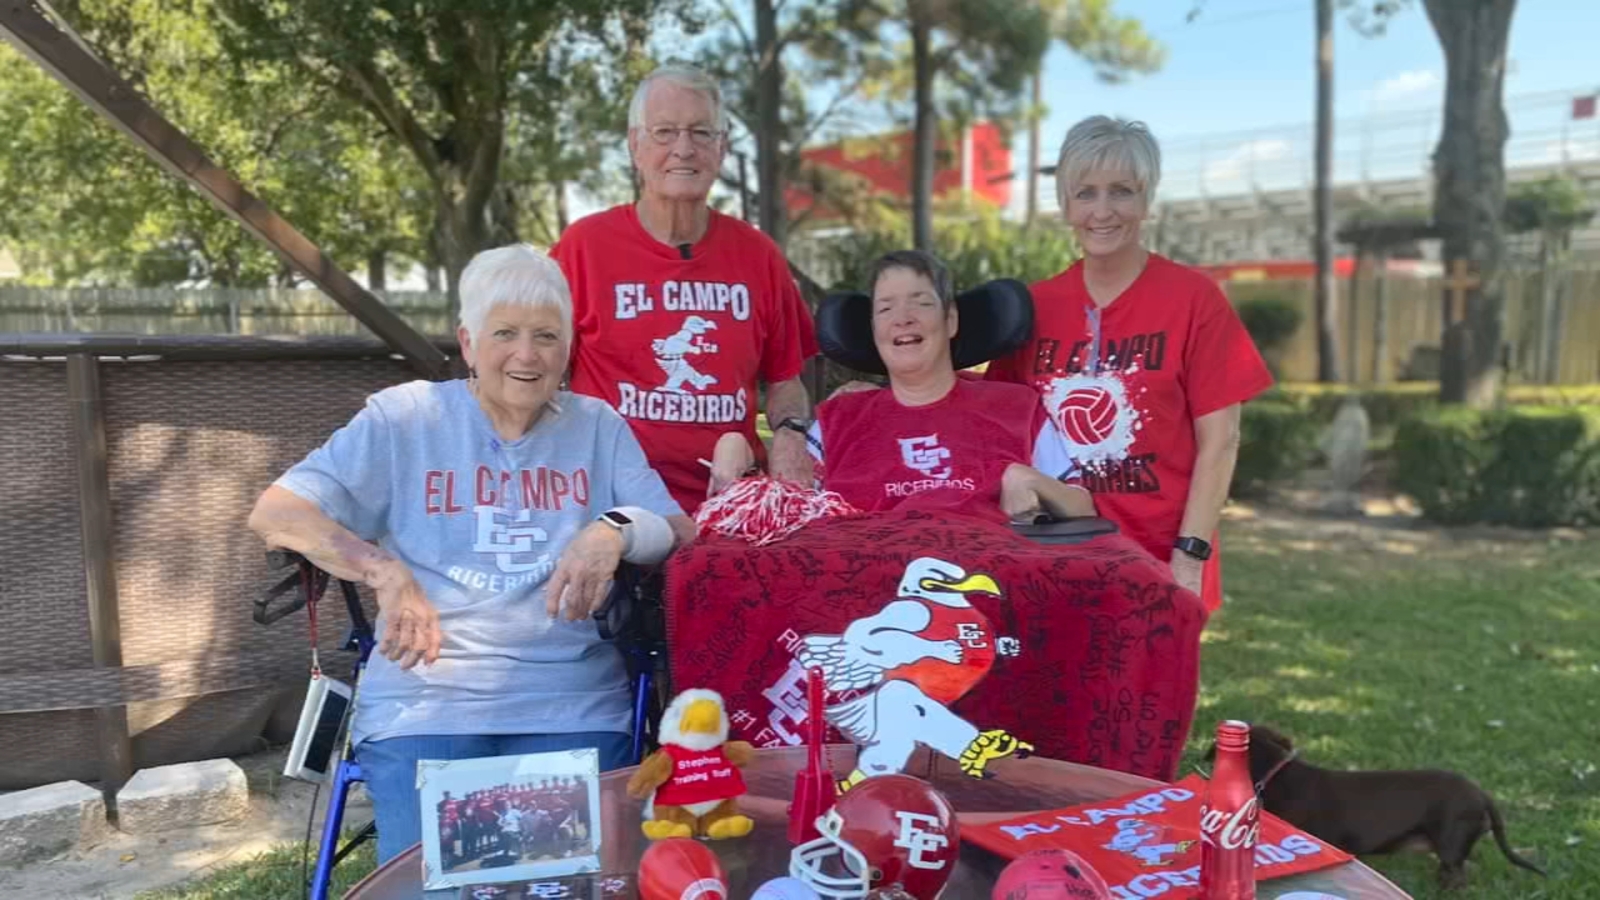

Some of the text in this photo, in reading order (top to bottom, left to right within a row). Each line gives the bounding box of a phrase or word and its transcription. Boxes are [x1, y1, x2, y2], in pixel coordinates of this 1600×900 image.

[613, 279, 751, 321] EL CAMPO
[617, 381, 747, 424] RICEBIRDS
[425, 469, 465, 515] EL
[730, 709, 757, 731] #1
[893, 810, 949, 870] EC
